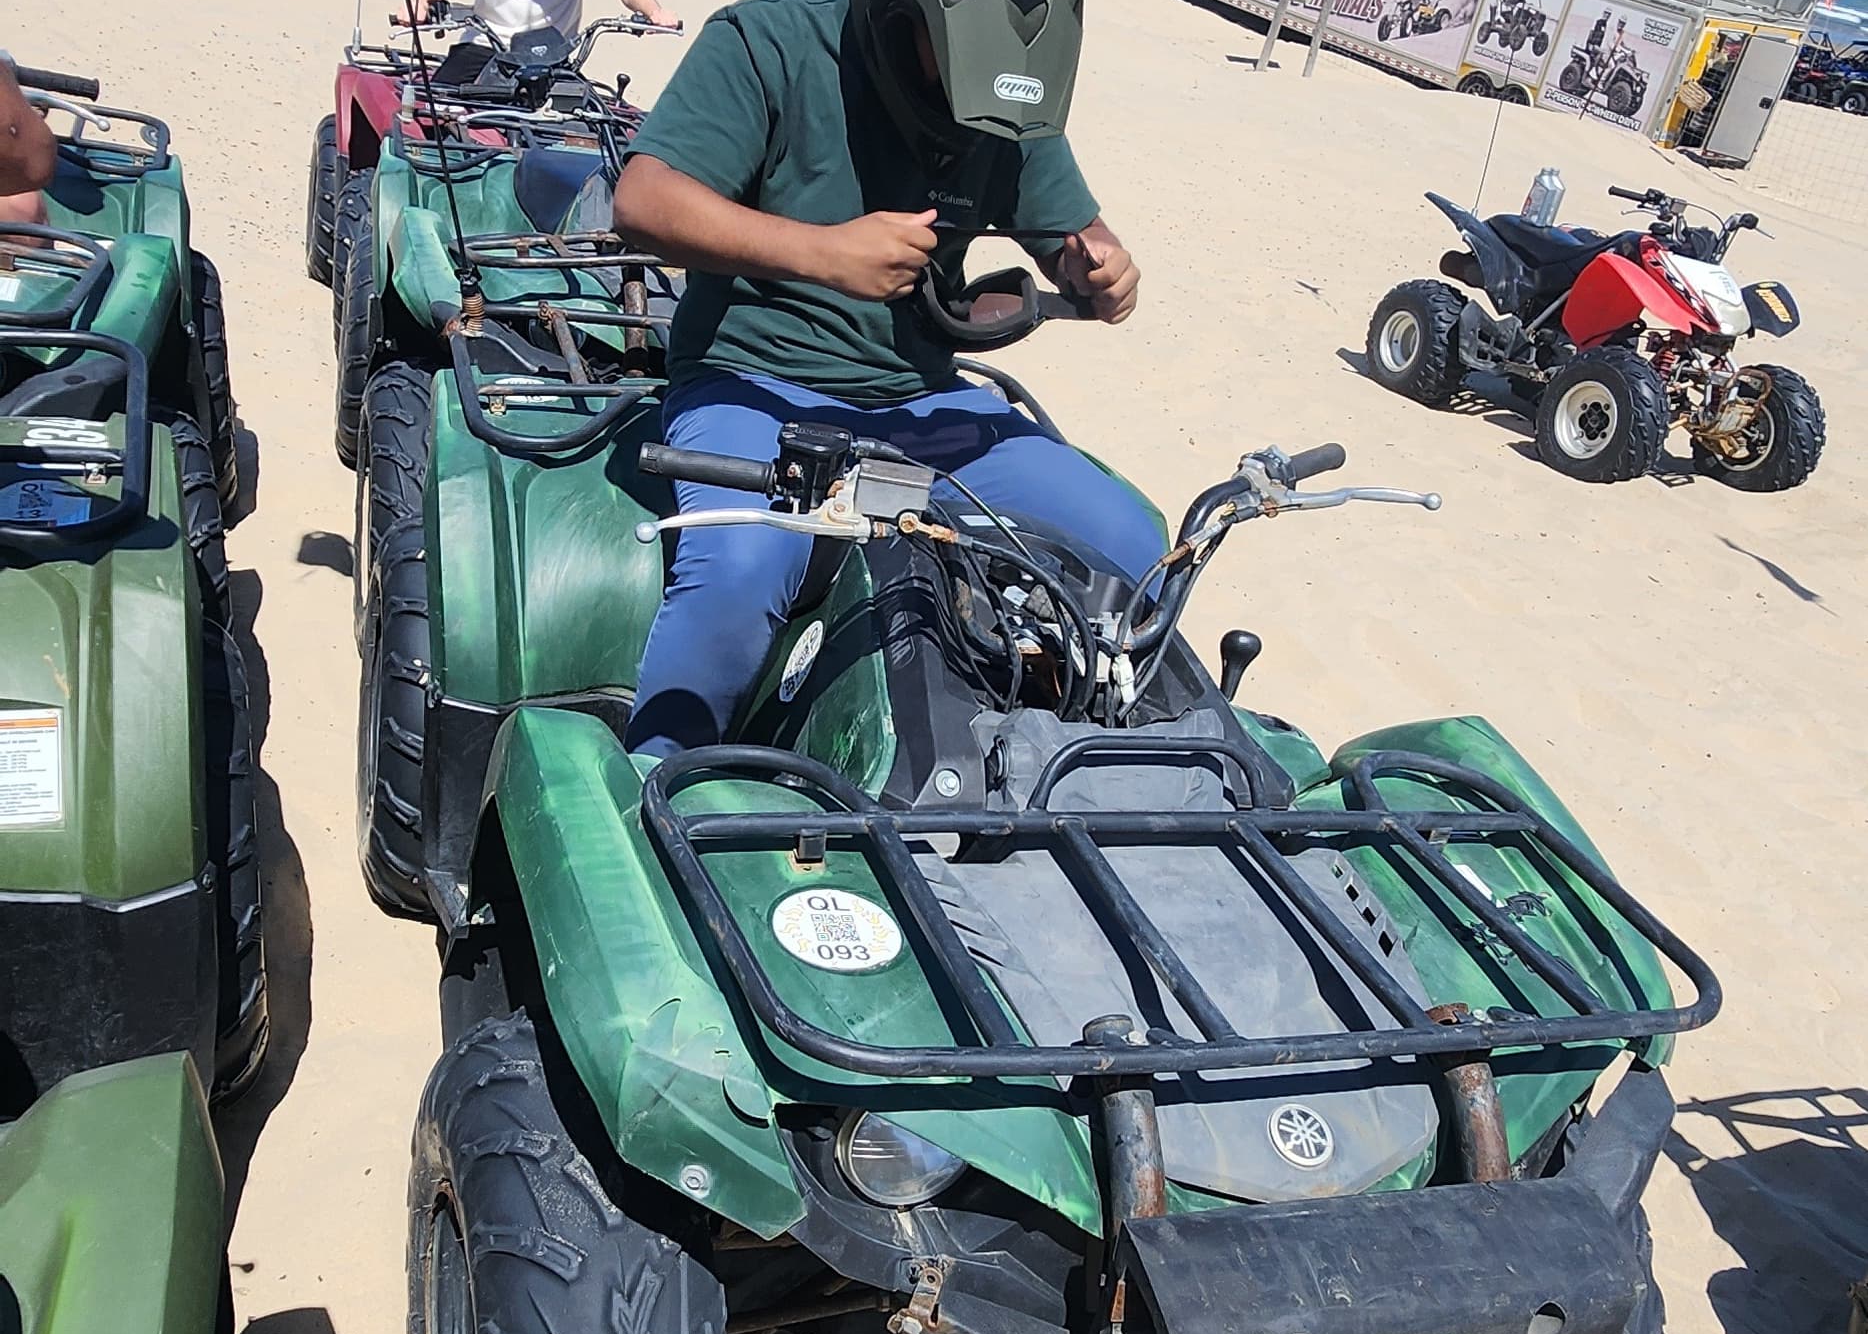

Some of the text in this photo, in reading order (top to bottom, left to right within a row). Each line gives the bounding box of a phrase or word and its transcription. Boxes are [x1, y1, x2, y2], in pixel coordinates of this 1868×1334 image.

[938, 191, 974, 207] Columbia
[807, 895, 851, 912] QL
[816, 944, 871, 961] 093
